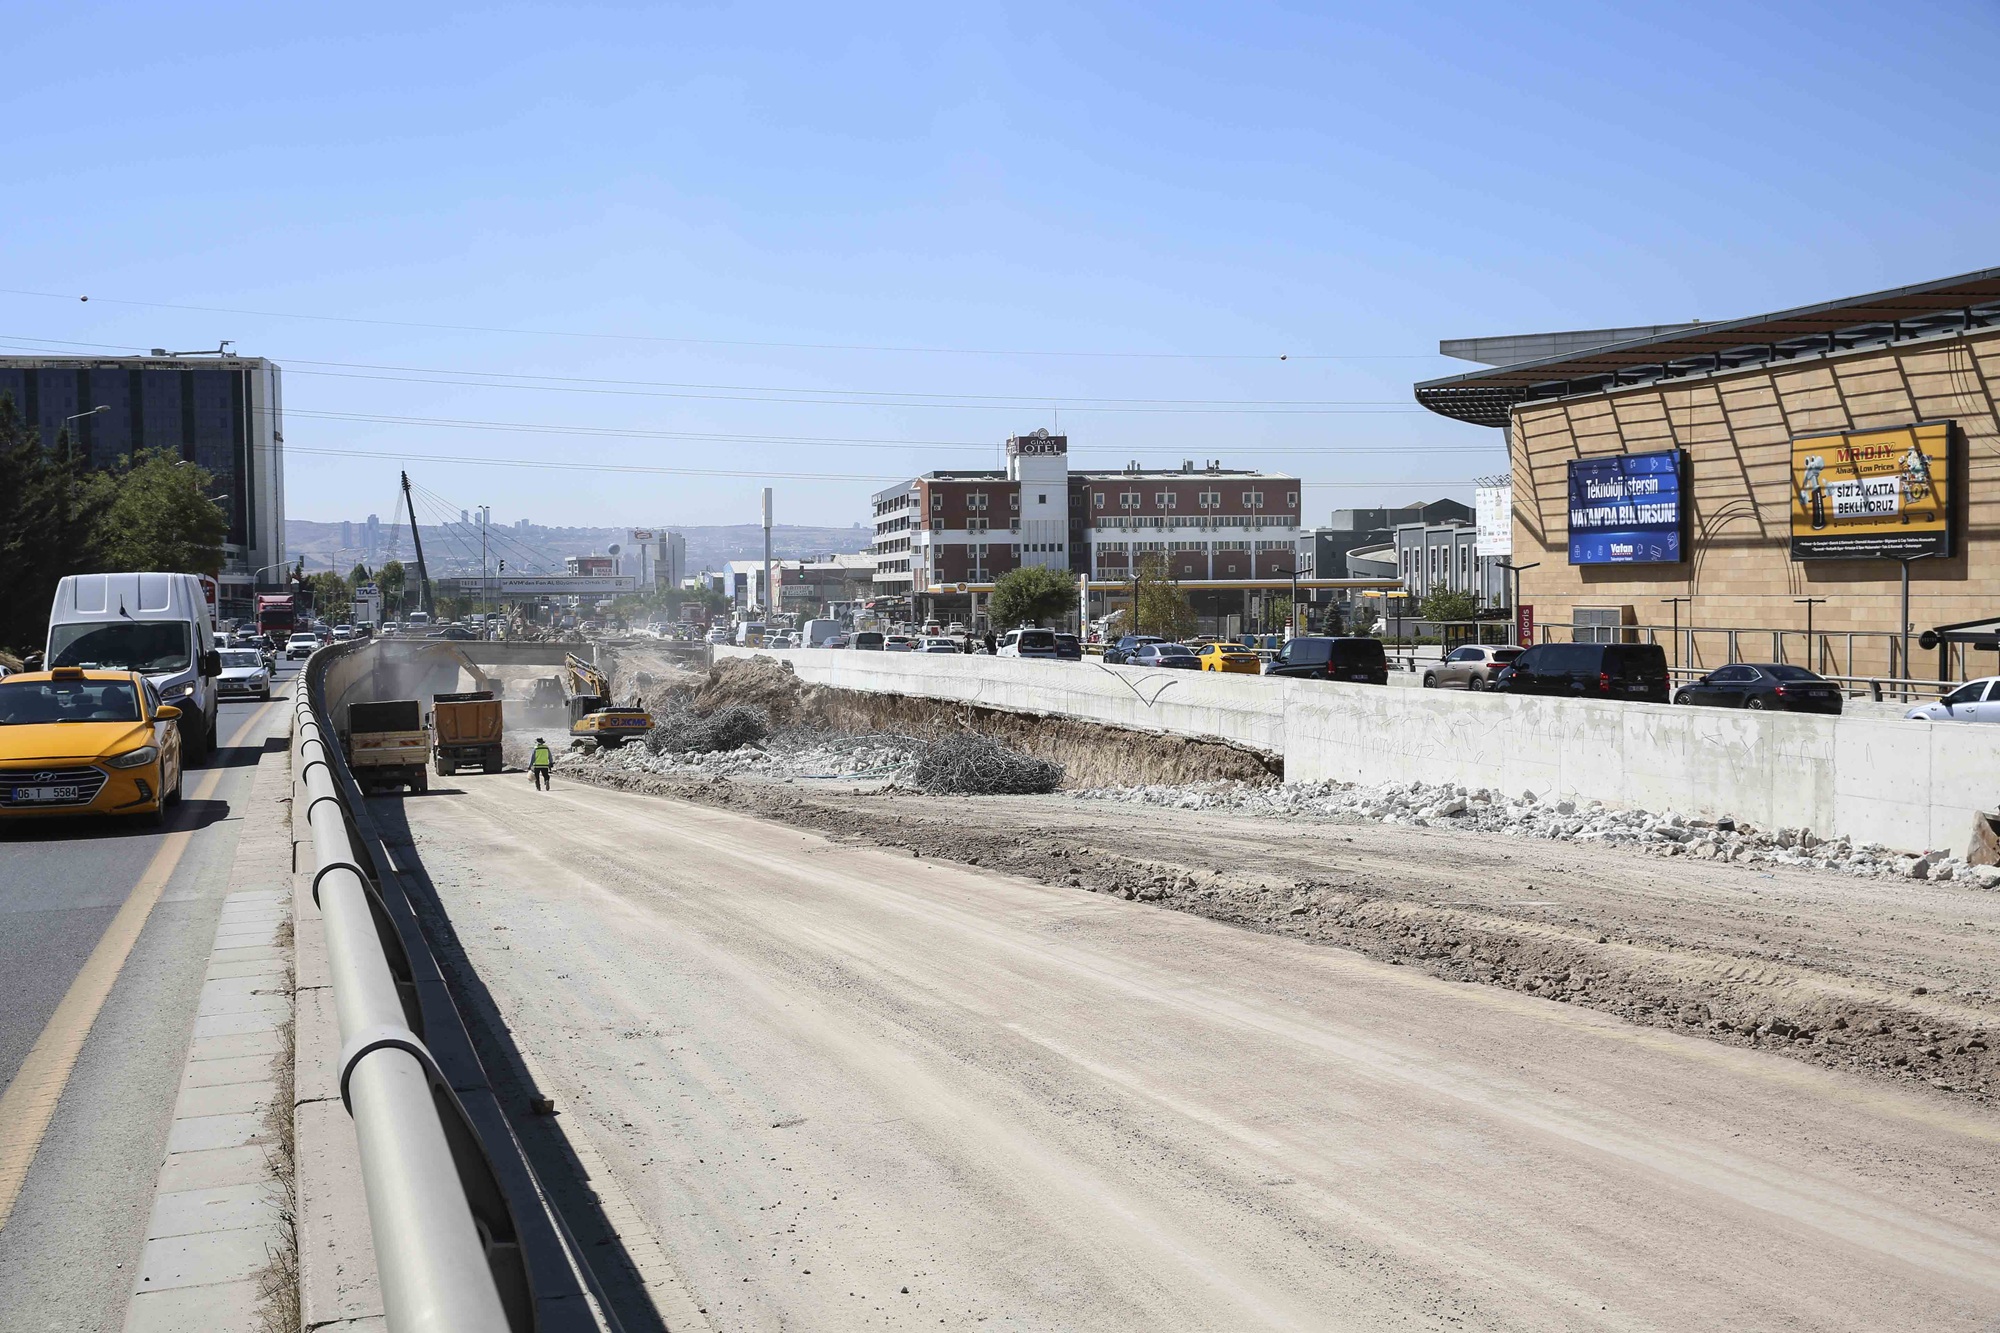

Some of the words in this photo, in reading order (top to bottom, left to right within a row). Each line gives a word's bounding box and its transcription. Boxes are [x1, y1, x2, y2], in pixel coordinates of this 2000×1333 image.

[1024, 444, 1062, 453] OTEL
[1860, 465, 1873, 473] Low
[1874, 464, 1895, 472] Prices
[1586, 475, 1623, 501] Teknoloji
[1624, 474, 1658, 496] istersin
[1837, 483, 1853, 498] SİZİ
[1855, 485, 1864, 497] 2.
[1866, 483, 1895, 496] KATTA
[1838, 499, 1894, 514] BEKLİYORUZ
[1571, 506, 1617, 527] VATAN'DA
[1619, 503, 1676, 525] BULURSUN!
[1610, 543, 1633, 553] Vatan
[18, 789, 30, 799] 06
[36, 788, 42, 798] T
[53, 787, 77, 798] 5584
